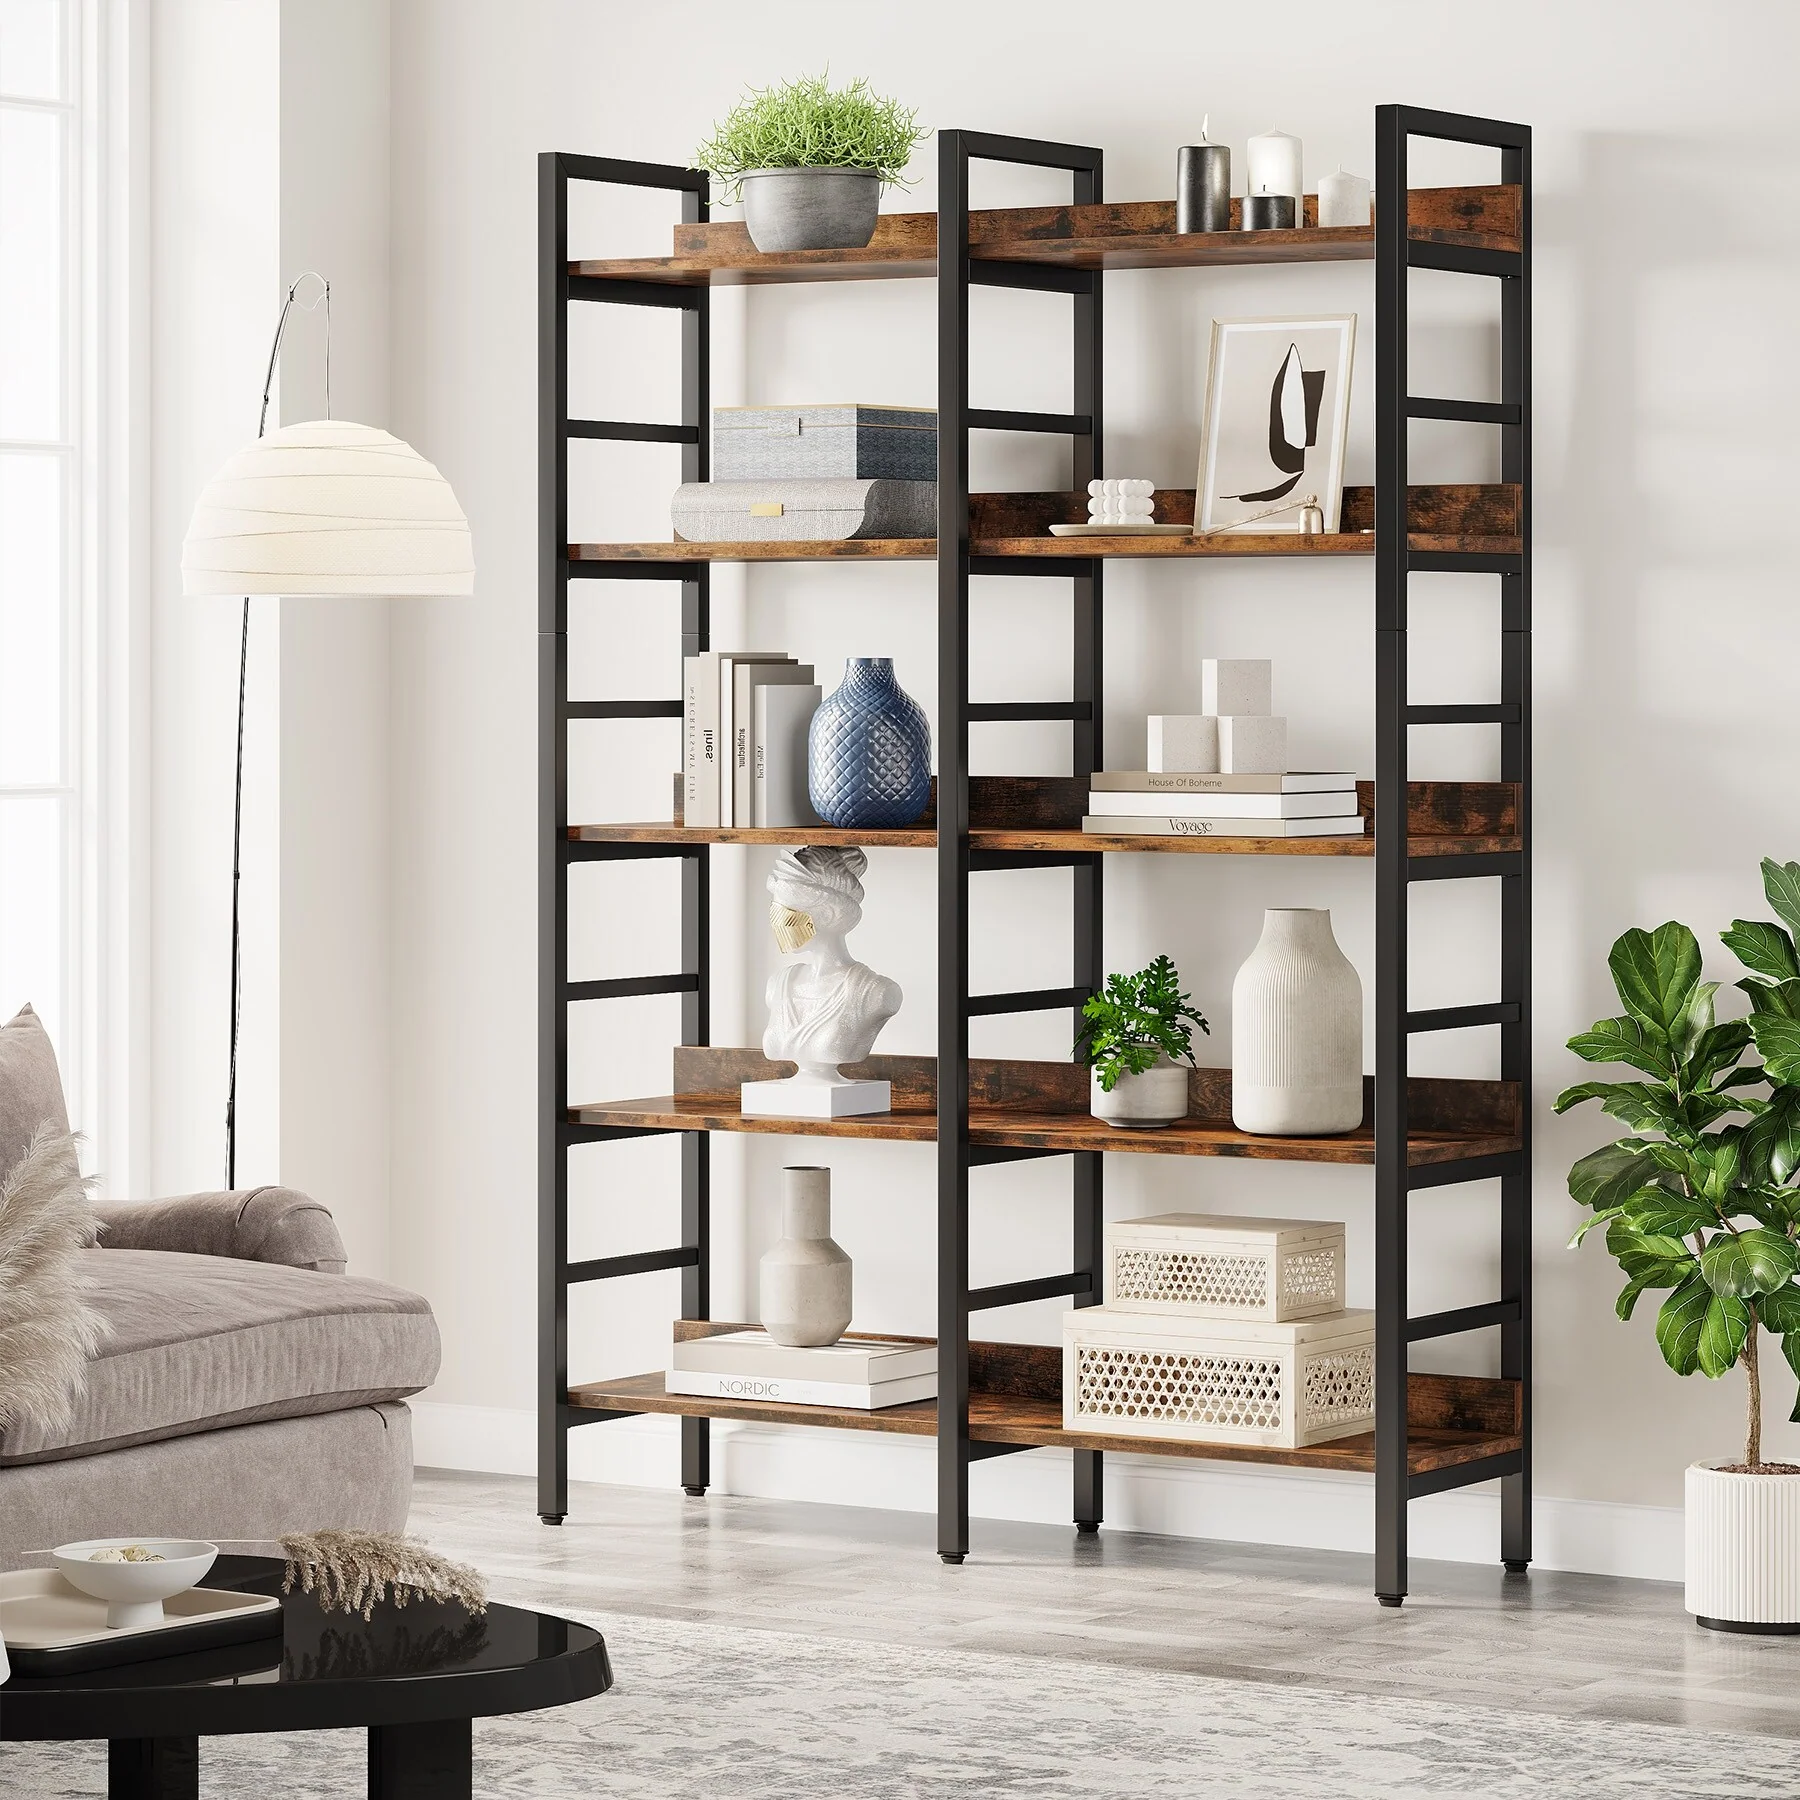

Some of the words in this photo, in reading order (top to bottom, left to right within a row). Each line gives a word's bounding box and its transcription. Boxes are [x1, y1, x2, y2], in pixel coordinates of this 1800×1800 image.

[1148, 778, 1174, 787] House
[1176, 778, 1187, 787] Of
[1189, 779, 1222, 788] Boheme
[1169, 818, 1213, 835] Voyage
[719, 1380, 780, 1397] NORDIC
